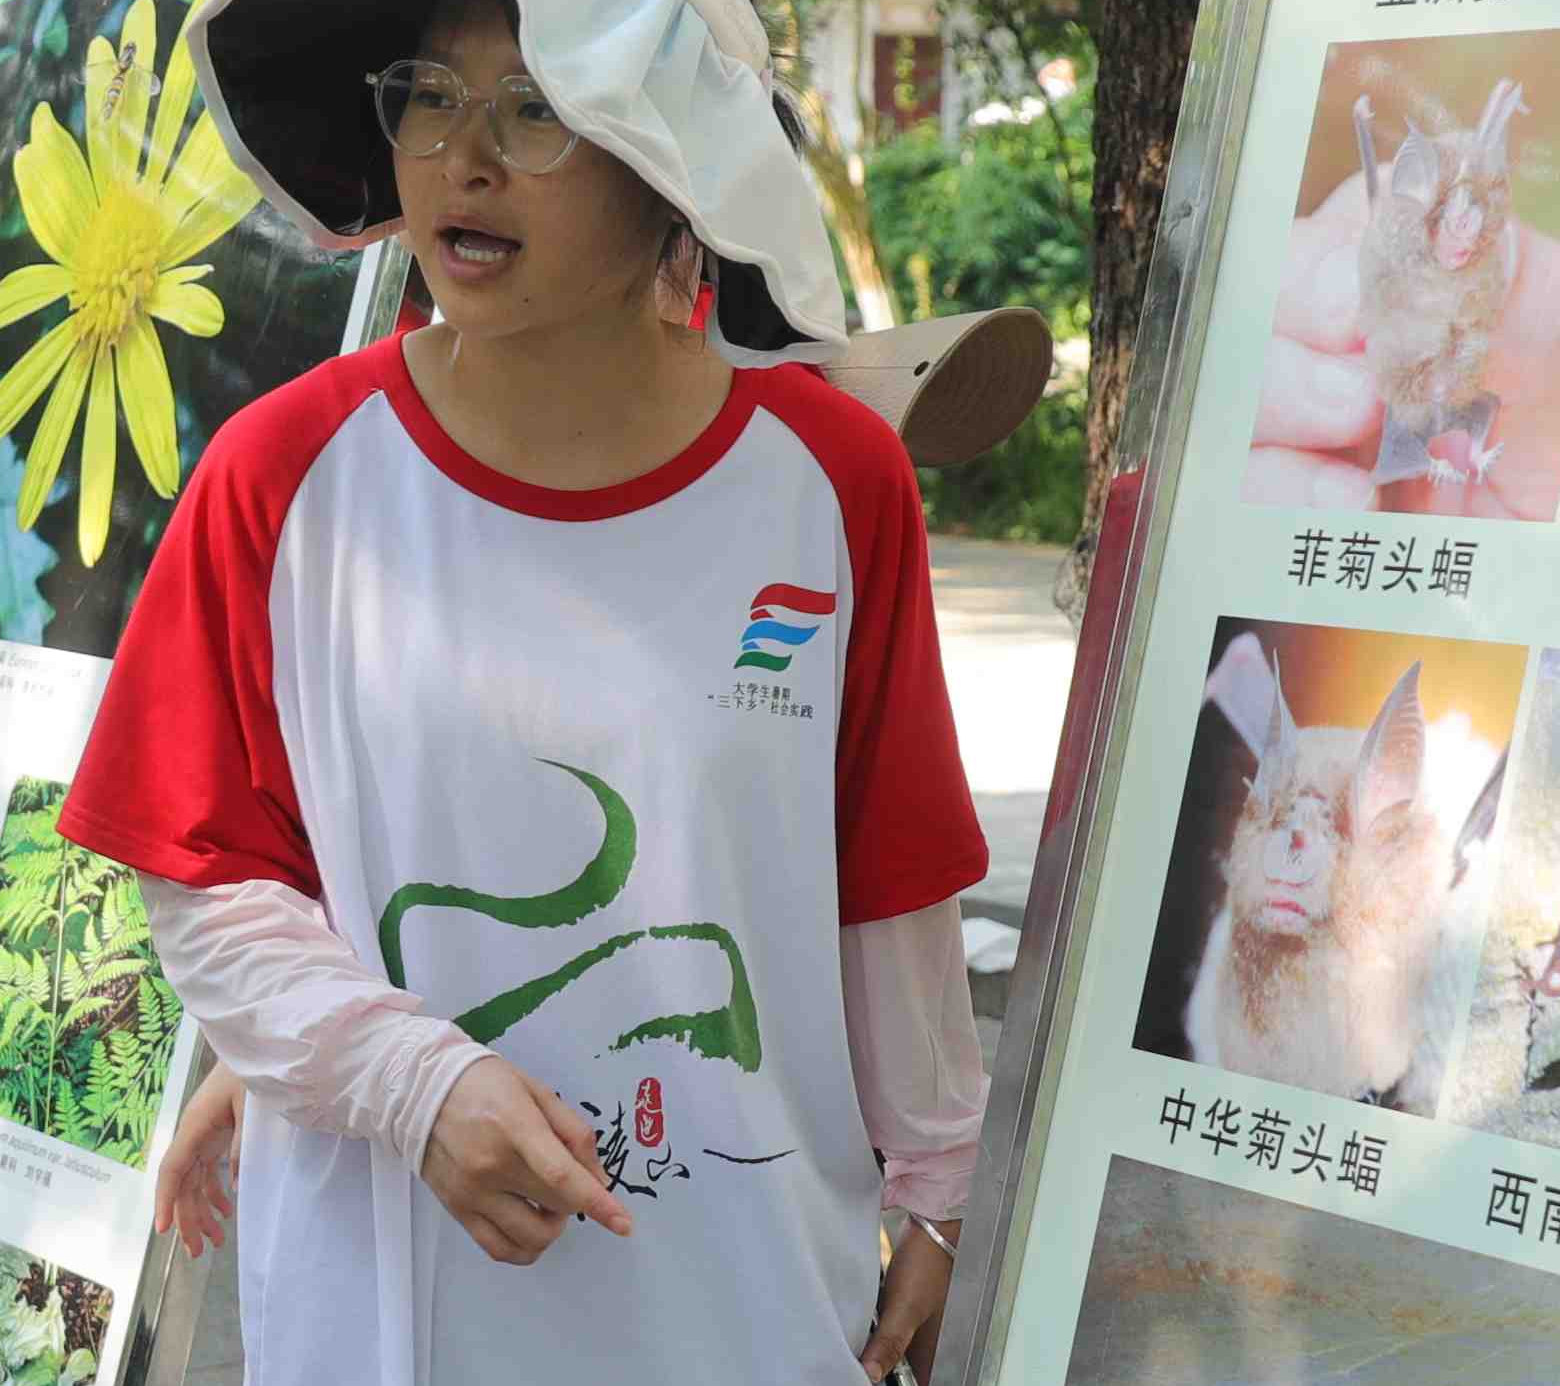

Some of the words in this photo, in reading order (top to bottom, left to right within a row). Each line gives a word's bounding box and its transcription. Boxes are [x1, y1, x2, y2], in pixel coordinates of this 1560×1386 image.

[1286, 528, 1478, 601] 菲菊头蝠
[1156, 1085, 1388, 1198] 中华菊头蝠
